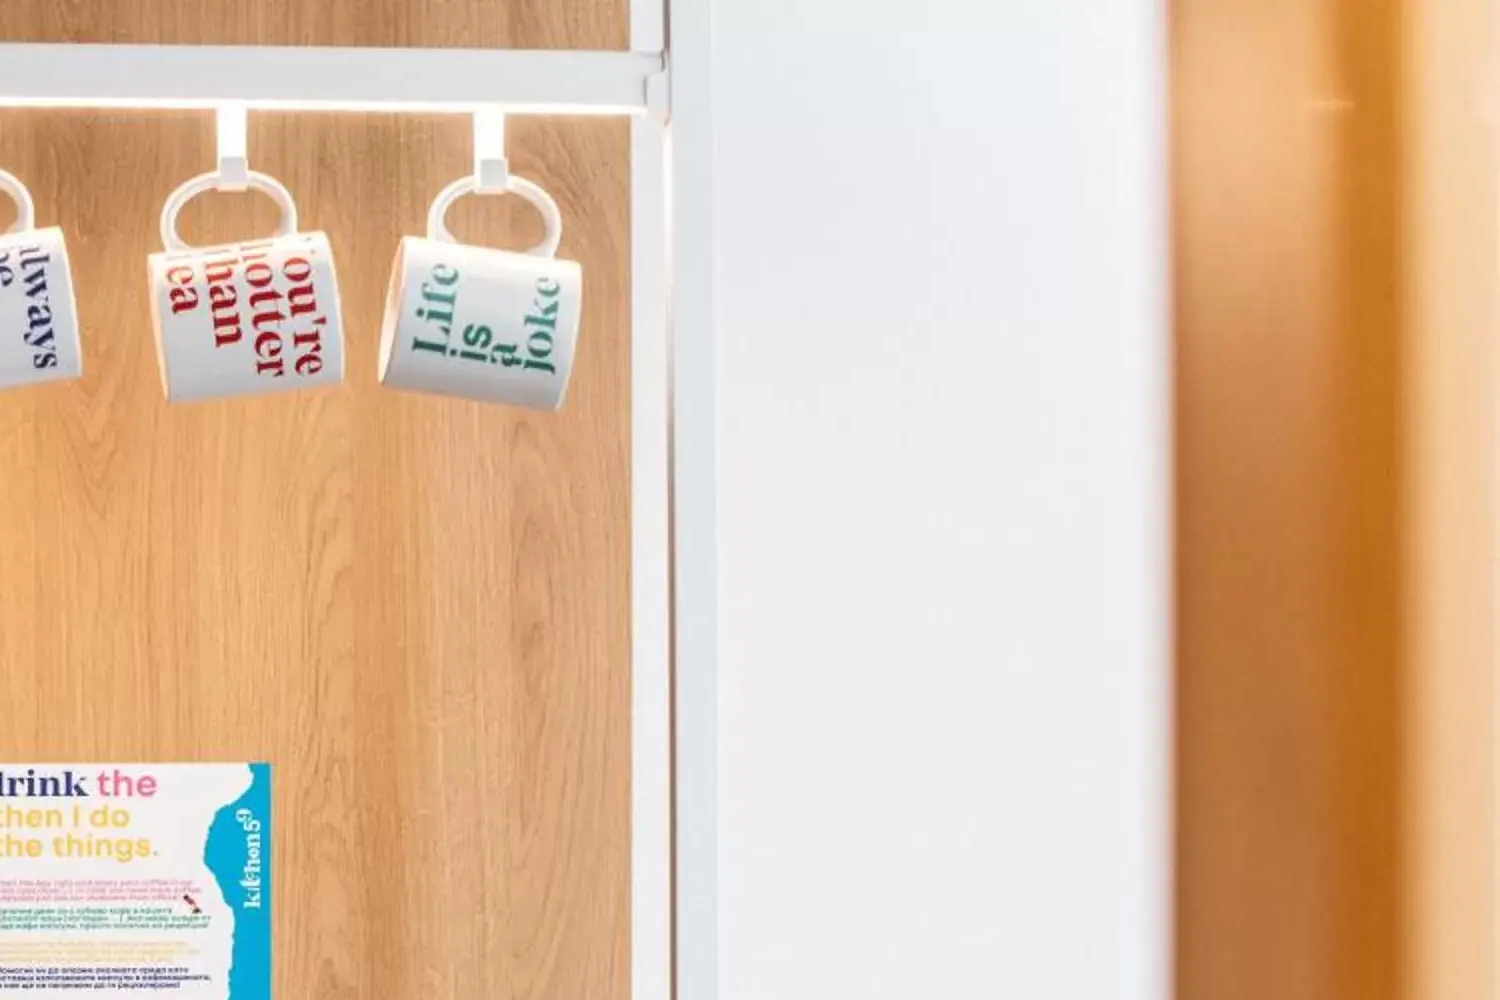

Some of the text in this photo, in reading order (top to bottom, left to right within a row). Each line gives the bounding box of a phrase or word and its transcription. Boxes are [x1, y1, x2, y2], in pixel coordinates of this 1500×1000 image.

[165, 256, 198, 314] ea
[202, 250, 242, 348] han
[283, 237, 327, 376] ou're
[412, 263, 459, 356] Life
[515, 277, 560, 375] joke
[450, 324, 493, 362] is
[490, 343, 517, 367] a
[96, 770, 157, 797] the
[73, 805, 80, 828] I
[89, 804, 131, 829] do
[52, 834, 159, 863] things.
